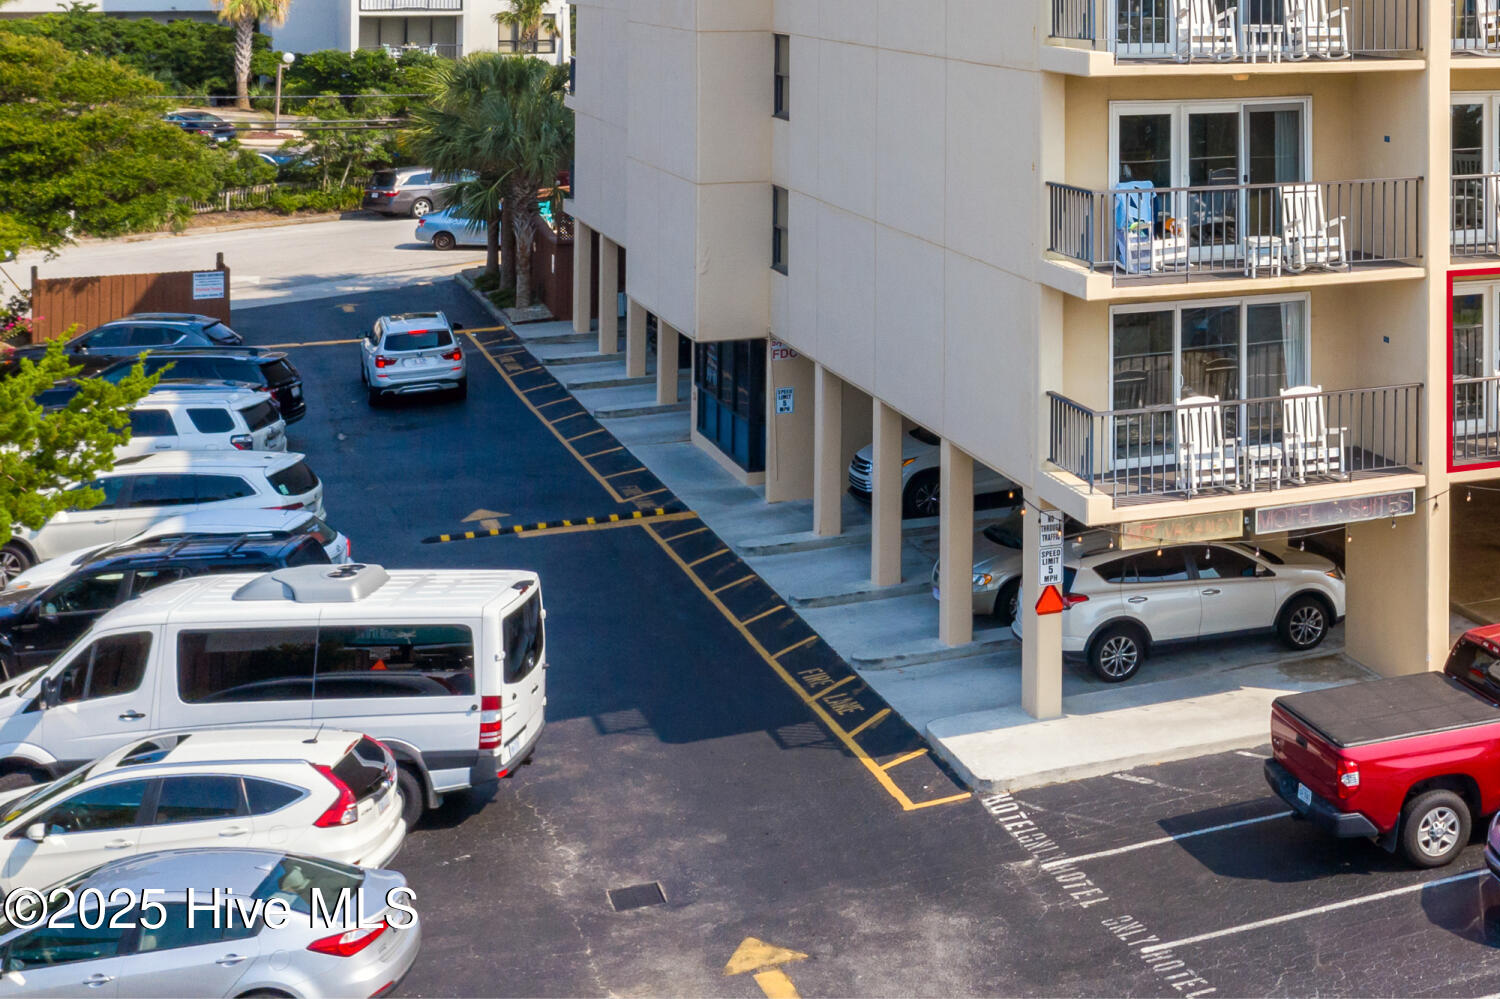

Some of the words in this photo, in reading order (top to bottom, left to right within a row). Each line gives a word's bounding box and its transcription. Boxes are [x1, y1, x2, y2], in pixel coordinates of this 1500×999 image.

[772, 348, 797, 359] FDC
[1258, 506, 1319, 529] MOTEL
[1350, 493, 1410, 517] SUITES
[1041, 524, 1060, 532] THROUG
[1164, 516, 1234, 538] VACANCY
[1041, 549, 1060, 558] SPEED
[1042, 557, 1060, 565] LIMIT
[1048, 565, 1054, 574] 5
[1044, 574, 1058, 582] MPH
[797, 668, 836, 688] FIRE
[823, 692, 865, 716] LANE
[1101, 914, 1160, 946] ONLY
